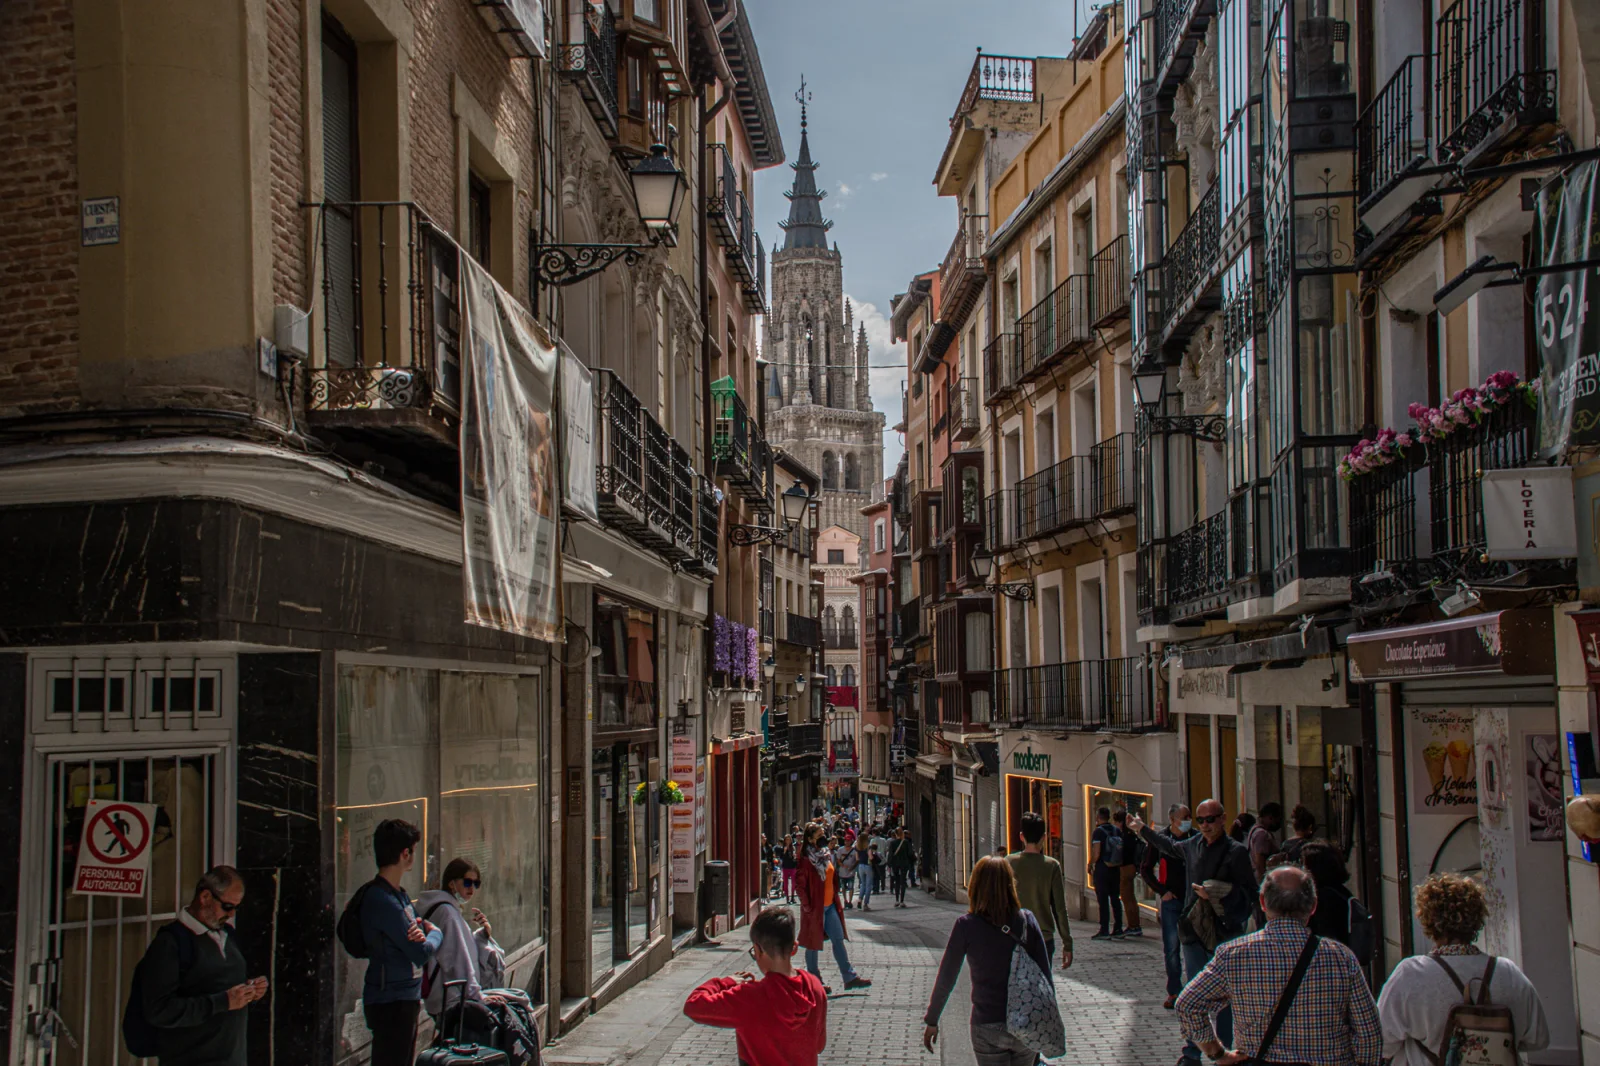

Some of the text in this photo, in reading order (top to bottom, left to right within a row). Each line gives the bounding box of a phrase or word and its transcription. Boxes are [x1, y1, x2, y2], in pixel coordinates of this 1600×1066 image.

[85, 201, 117, 216] CUESTA
[1521, 479, 1537, 550] LOTERIA
[1386, 639, 1445, 662] Chocolate Experience
[1422, 714, 1456, 724] Chocolate
[1013, 746, 1052, 778] moolberry
[80, 867, 142, 880] PERSONAL NO
[82, 879, 137, 892] AUTORIZADO
